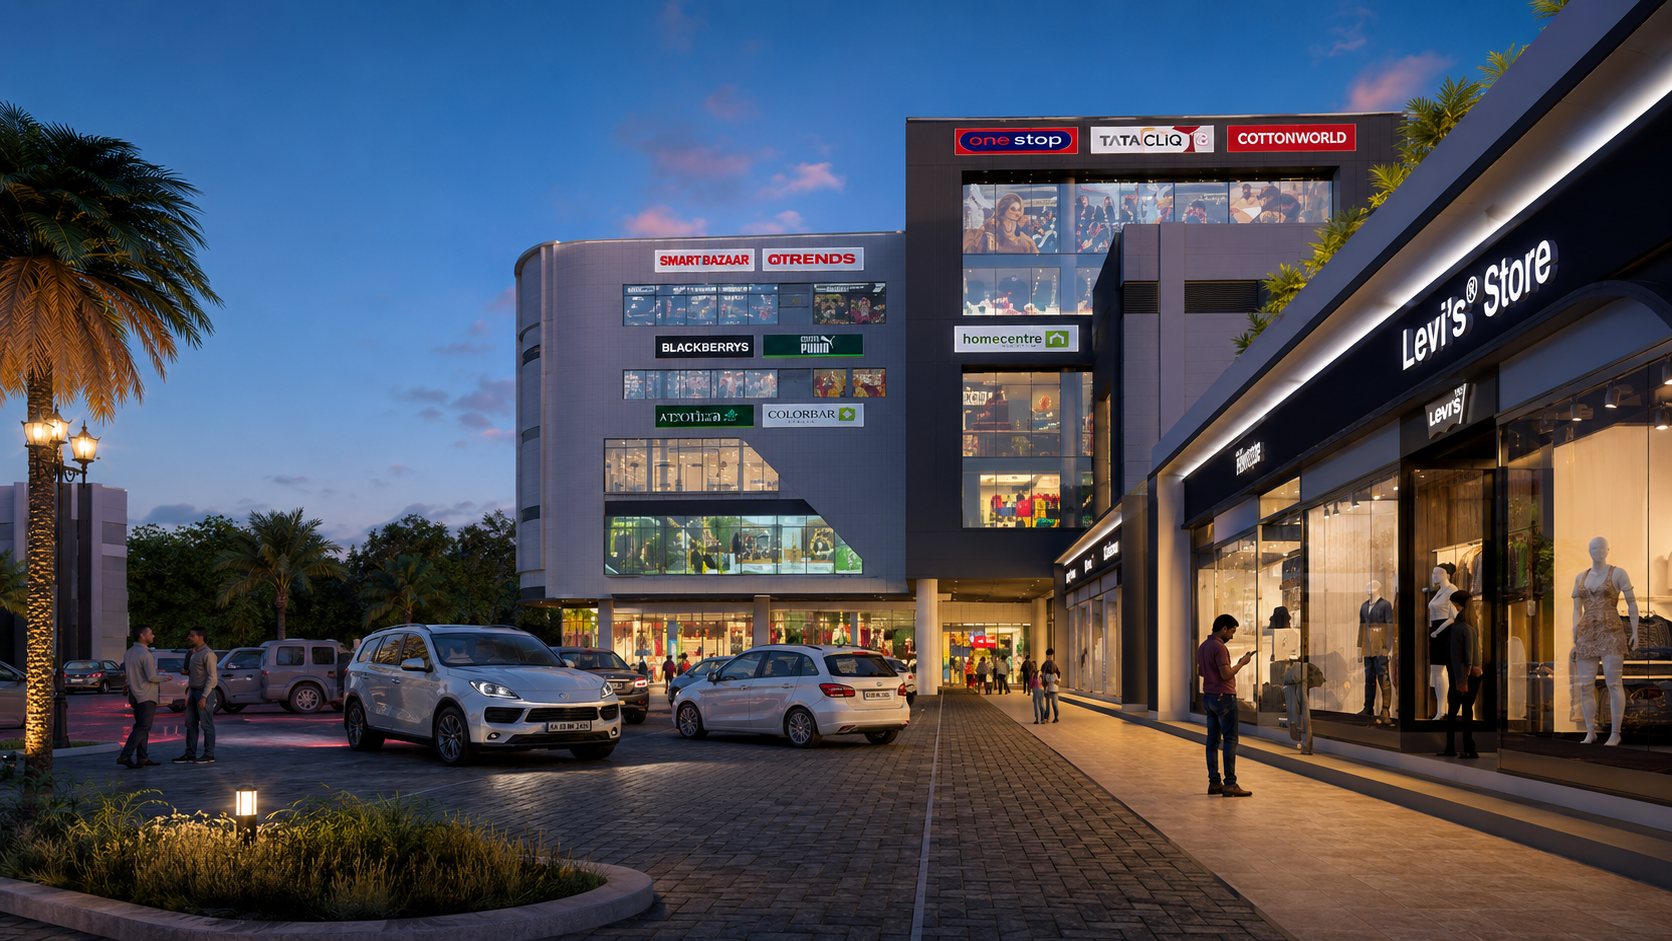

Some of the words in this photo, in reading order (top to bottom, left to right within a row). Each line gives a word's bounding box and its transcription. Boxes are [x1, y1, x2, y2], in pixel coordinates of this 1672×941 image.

[969, 136, 1010, 147] one
[1014, 134, 1062, 148] stop
[1237, 131, 1347, 145] COTTONWORLD
[659, 254, 701, 267] SMART
[702, 254, 750, 266] BAZAAR
[1484, 239, 1551, 318] Store
[963, 333, 1043, 344] homecentre
[661, 342, 749, 353] BLACKBERRYS
[767, 409, 836, 420] COLORBAR
